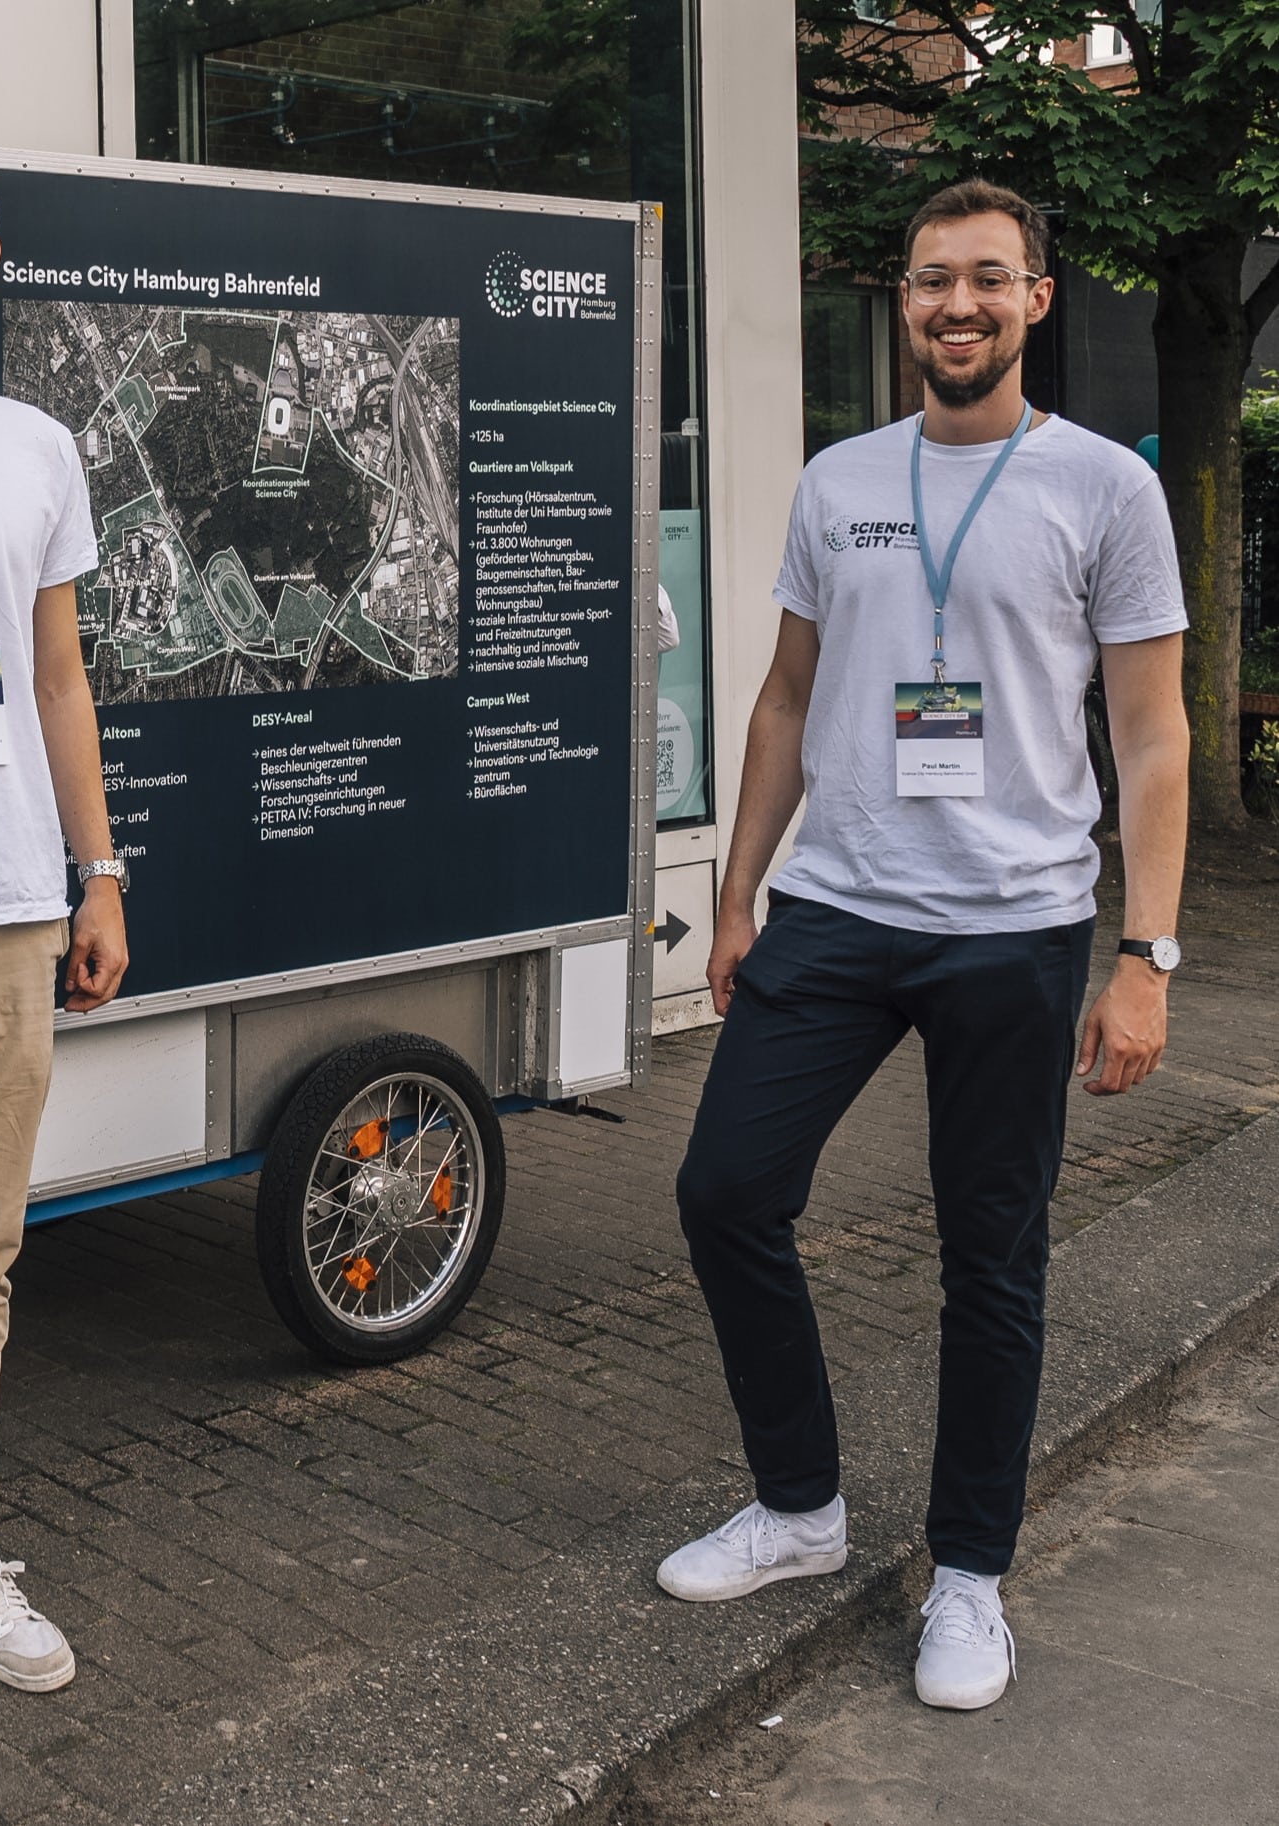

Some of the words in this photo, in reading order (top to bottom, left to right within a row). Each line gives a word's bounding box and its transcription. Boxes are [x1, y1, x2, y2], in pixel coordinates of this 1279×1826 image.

[2, 260, 83, 286] Science
[87, 265, 129, 293] City
[133, 268, 220, 298] Hamburg
[224, 272, 321, 298] Bahrenfeld
[520, 268, 607, 295] SCIENCE
[532, 295, 579, 318] CITY
[580, 298, 616, 310] Hamburg
[580, 310, 616, 320] Bahrenfeld
[469, 399, 561, 415] Koordinationsgebiet
[562, 400, 596, 413] Science
[598, 401, 617, 416] City
[476, 430, 492, 443] 125
[493, 430, 504, 443] ha
[469, 461, 513, 473] Quartiere
[515, 464, 529, 473] am
[530, 460, 574, 475] Volkspark
[242, 478, 310, 489] Koordinationsgebiet
[255, 489, 282, 498] Science
[283, 489, 298, 499] City
[476, 491, 523, 505] Forschung
[525, 490, 597, 504] (Hörsaalzentrum,
[476, 507, 514, 519] Institute
[514, 506, 529, 518] der
[530, 506, 545, 518] Uni
[547, 505, 586, 520] Hamburg
[588, 504, 612, 516] sowie
[476, 521, 527, 534] Fraunhofer)
[849, 522, 918, 535] SCIENCE
[476, 539, 488, 550] rd.
[490, 537, 518, 550] 3.800
[520, 537, 572, 550] Wohnungen
[855, 536, 894, 548] CITY
[476, 552, 529, 568] (geförderter
[530, 550, 594, 565] Wohnungsbau,
[476, 567, 564, 583] Baugemeinschaften,
[566, 565, 586, 577] Bau-
[476, 582, 557, 599] genossenschaften,
[558, 580, 572, 592] frei
[573, 578, 620, 590] finanzierter
[475, 596, 543, 612] Wohnungsbau)
[475, 613, 505, 627] soziale
[507, 610, 559, 625] Infrastruktur
[560, 609, 585, 621] sowie
[586, 608, 612, 622] Sport-
[475, 629, 493, 642] und
[495, 626, 571, 641] Freizeitnutzungen
[475, 643, 521, 657] nachhaltig
[523, 641, 540, 653] und
[541, 639, 580, 652] innovativ
[475, 659, 514, 673] intensive
[516, 656, 545, 669] soziale
[547, 654, 589, 668] Mischung
[467, 696, 504, 709] Campus
[506, 692, 530, 705] West
[252, 709, 313, 727] DESY-Areal
[102, 726, 141, 740] Altona
[474, 721, 540, 738] Wissenschafts-
[542, 718, 559, 731] und
[260, 746, 288, 759] eines
[289, 744, 307, 757] der
[308, 739, 350, 755] weltweit
[352, 734, 401, 750] führenden
[474, 736, 559, 753] Universitätsnutzung
[474, 753, 528, 769] Innovations-
[529, 750, 547, 763] und
[548, 744, 599, 761] Technologie
[261, 755, 367, 776] Beschleunigerzentren
[104, 772, 188, 792] ESY-Innovation
[261, 773, 336, 792] Wissenschafts-
[338, 770, 358, 783] und
[474, 770, 511, 784] zentrum
[261, 784, 385, 808] Forschungseinrichtungen
[474, 783, 527, 799] Büroflächen
[127, 808, 149, 823] und
[261, 808, 296, 825] PETRA
[298, 807, 312, 820] IV:
[314, 801, 366, 819] Forschung
[367, 800, 376, 812] in
[378, 798, 407, 811] neuer
[261, 824, 314, 841] Dimension
